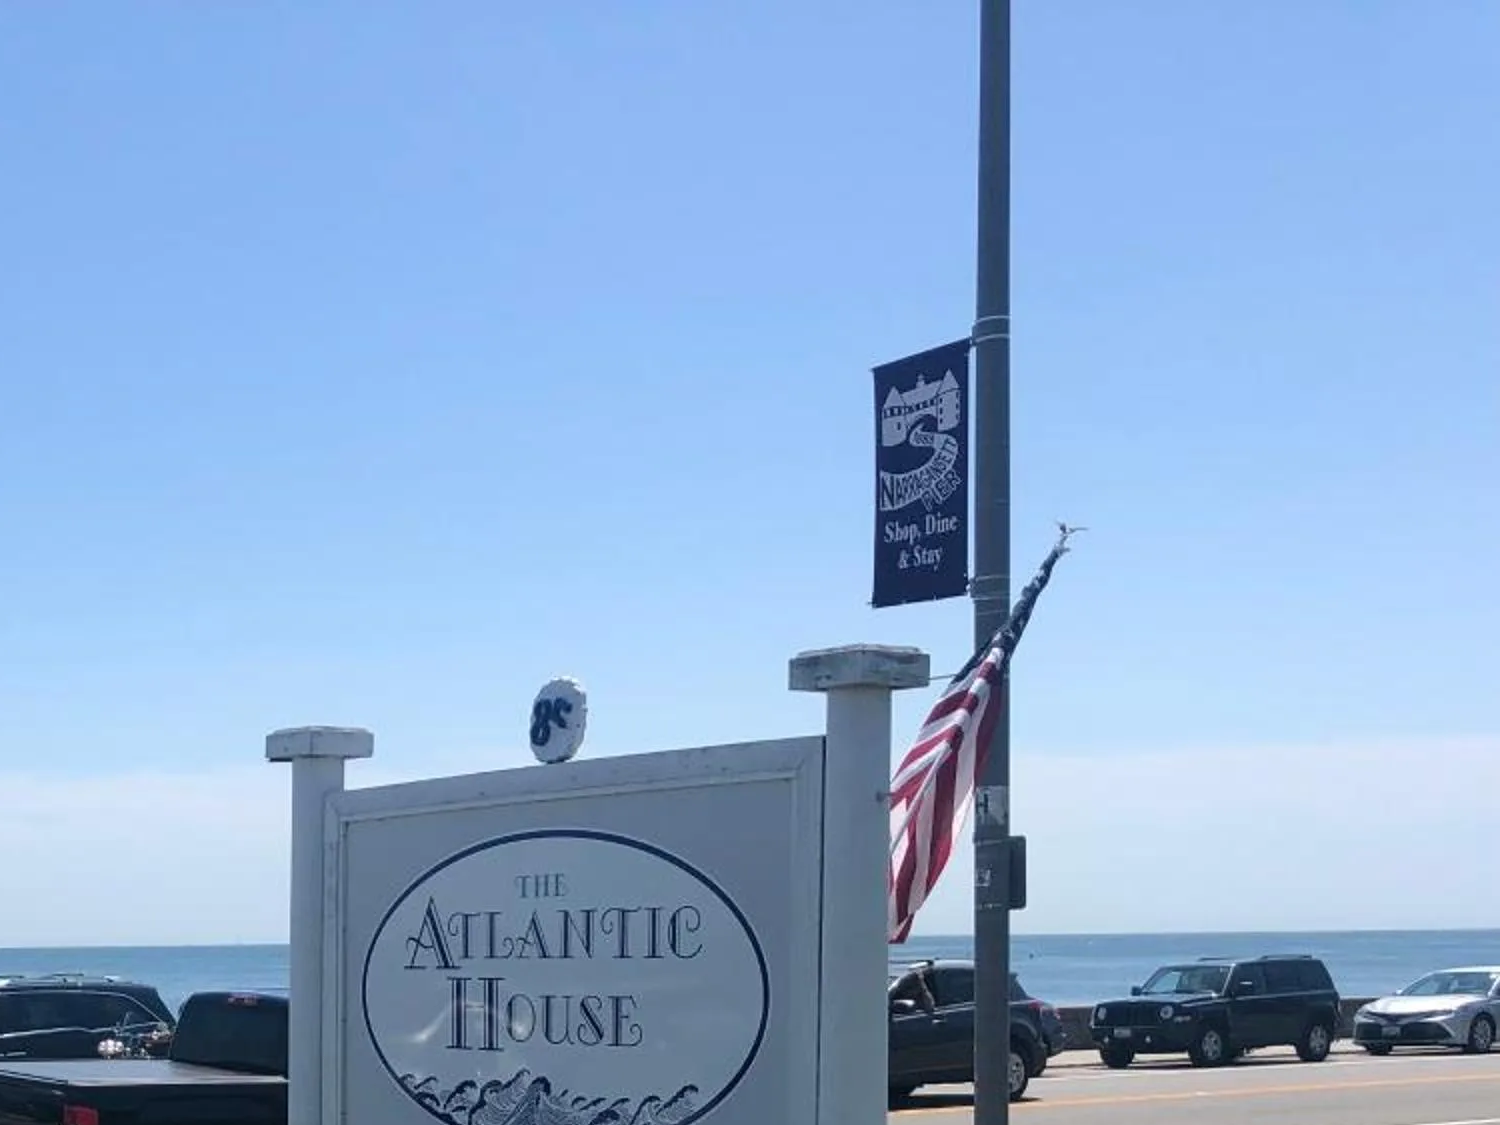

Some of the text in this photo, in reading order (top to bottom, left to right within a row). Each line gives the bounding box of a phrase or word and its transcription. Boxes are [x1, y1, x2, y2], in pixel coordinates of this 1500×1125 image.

[883, 512, 958, 545] Shop, Dine
[898, 544, 943, 571] & Stay
[514, 873, 567, 898] THE
[404, 896, 703, 970] ATLANTIC
[446, 976, 644, 1051] HOUSE
